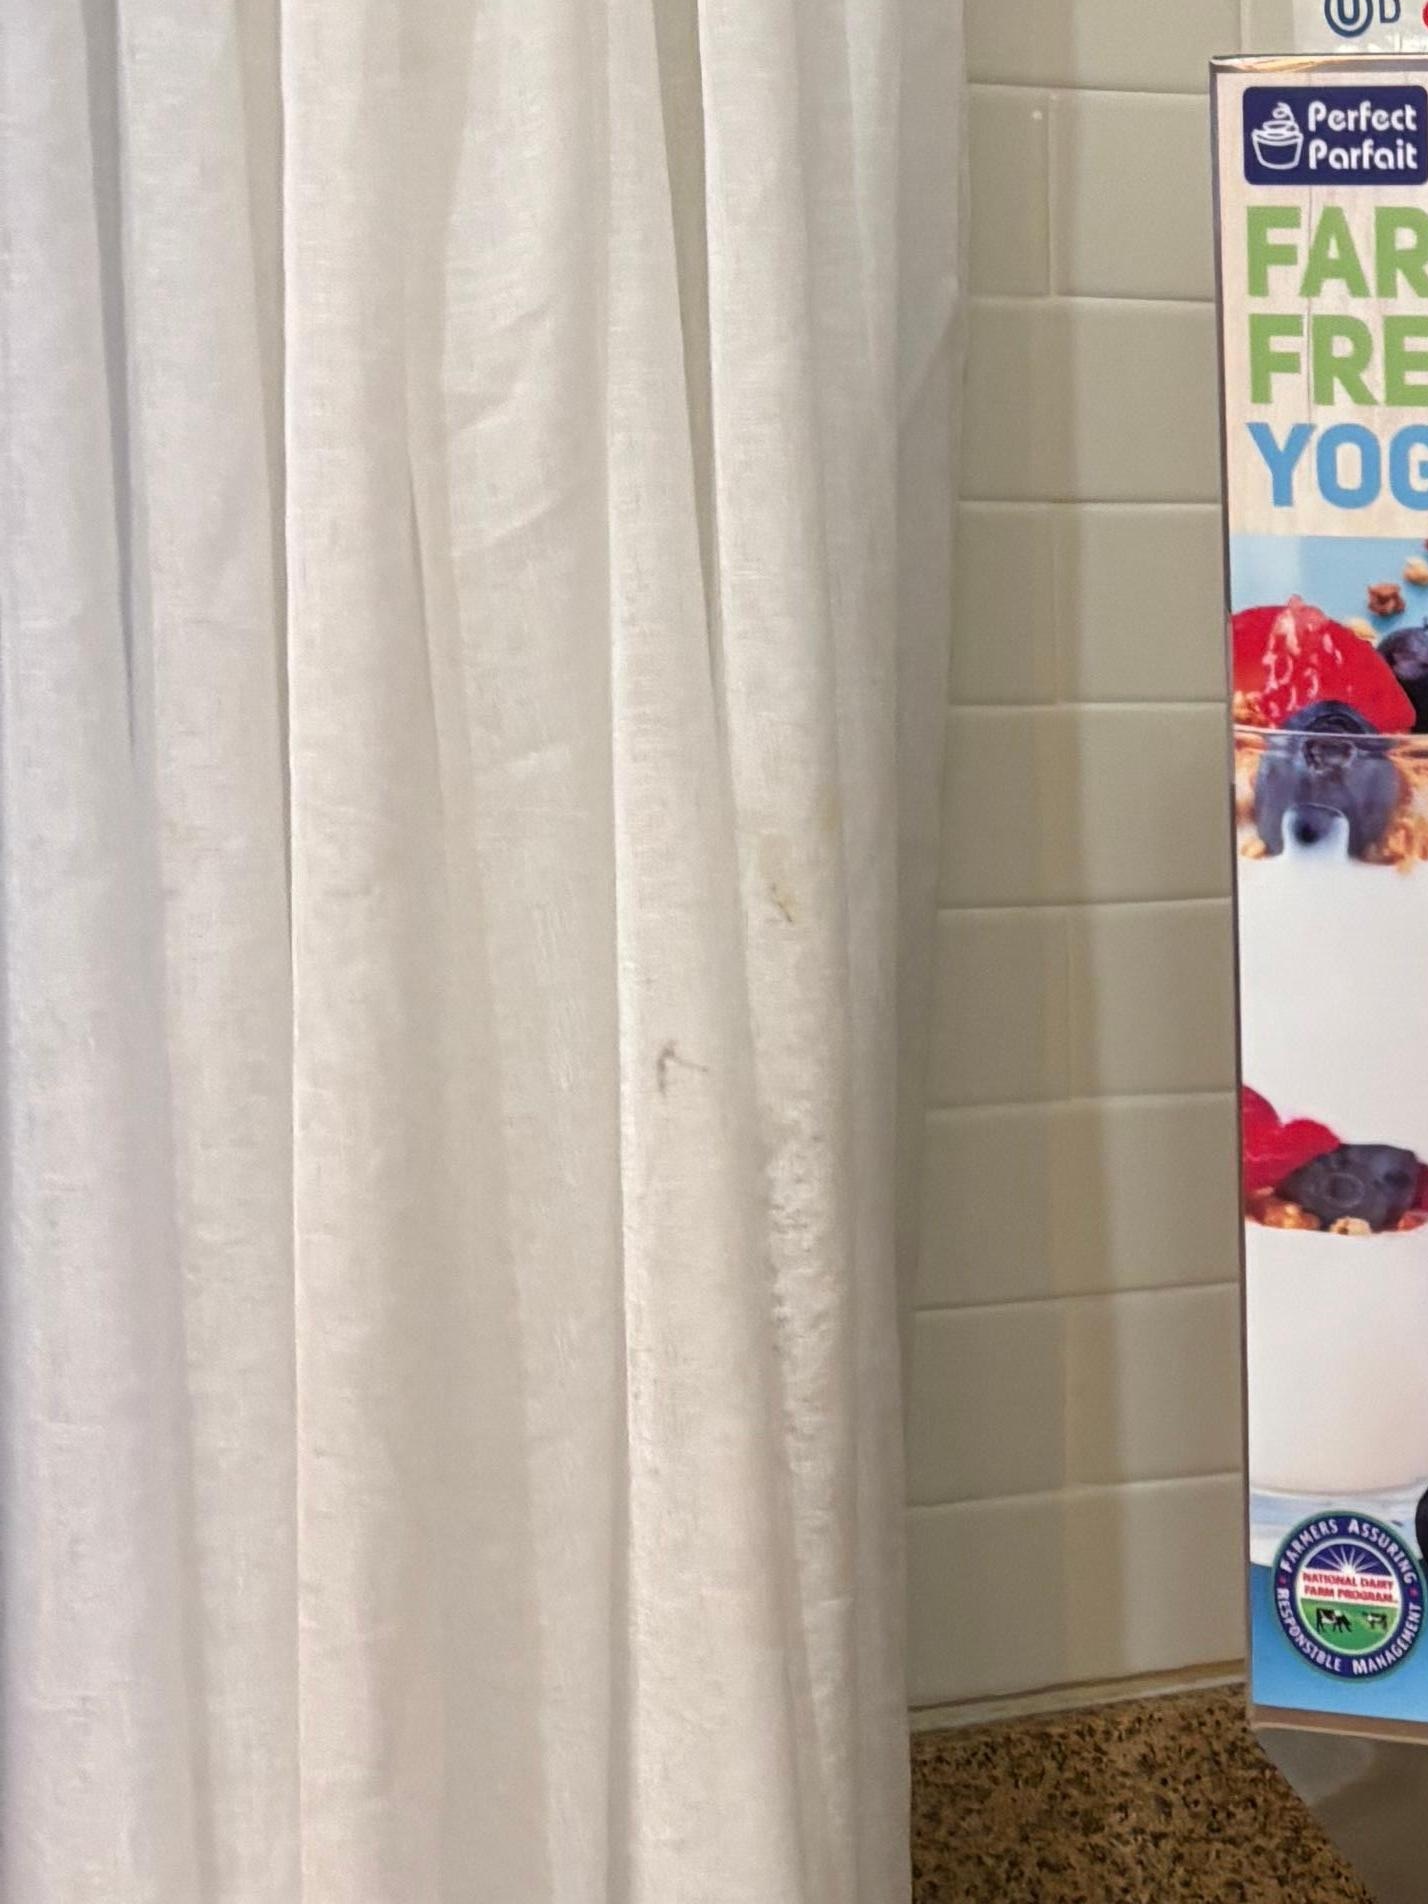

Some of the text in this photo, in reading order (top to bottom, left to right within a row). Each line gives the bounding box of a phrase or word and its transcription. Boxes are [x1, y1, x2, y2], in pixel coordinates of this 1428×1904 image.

[1308, 100, 1417, 132] Perfect
[1308, 138, 1418, 170] Parfait
[1280, 1518, 1417, 1584] FARMERS ASSURING
[1303, 1572, 1394, 1589] NATIONAL DAIRY
[1304, 1585, 1335, 1597] FARM
[1277, 1588, 1422, 1675] RESPONSIBLE MANAGEMENT
